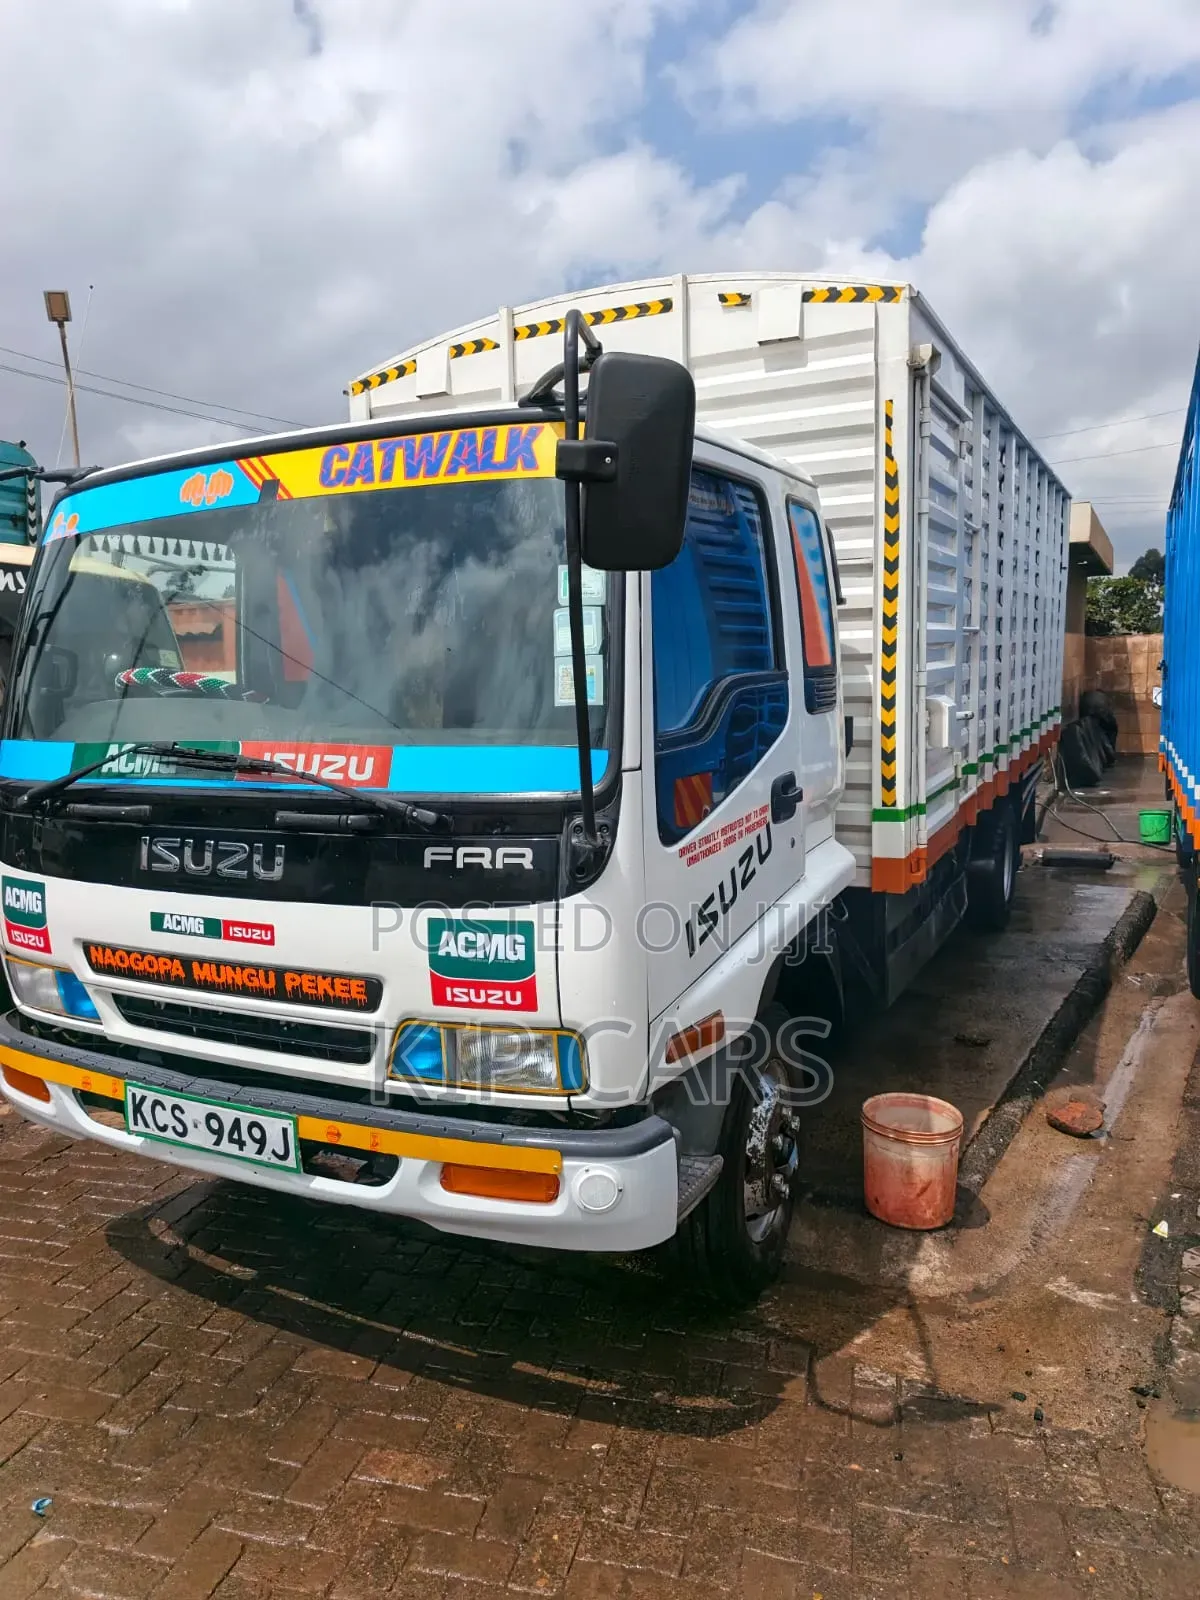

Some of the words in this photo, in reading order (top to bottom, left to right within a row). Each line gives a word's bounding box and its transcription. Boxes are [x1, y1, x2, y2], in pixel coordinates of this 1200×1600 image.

[319, 425, 544, 488] CATWALK
[140, 836, 286, 881] ISUZU
[424, 846, 534, 869] FRR
[678, 841, 697, 858] DRIVER
[5, 886, 43, 914] ACMG
[685, 821, 773, 959] ISUZU
[11, 929, 45, 948] ISUZU
[163, 913, 205, 935] ACMG
[229, 926, 271, 940] ISUZU
[438, 931, 526, 964] ACMG
[89, 946, 185, 982] NAOGOPA
[192, 961, 276, 997] MUNGU
[284, 972, 368, 1006] PEKEE
[445, 987, 522, 1005] ISUZU
[131, 1091, 188, 1137] KCS
[205, 1111, 291, 1162] 949J
